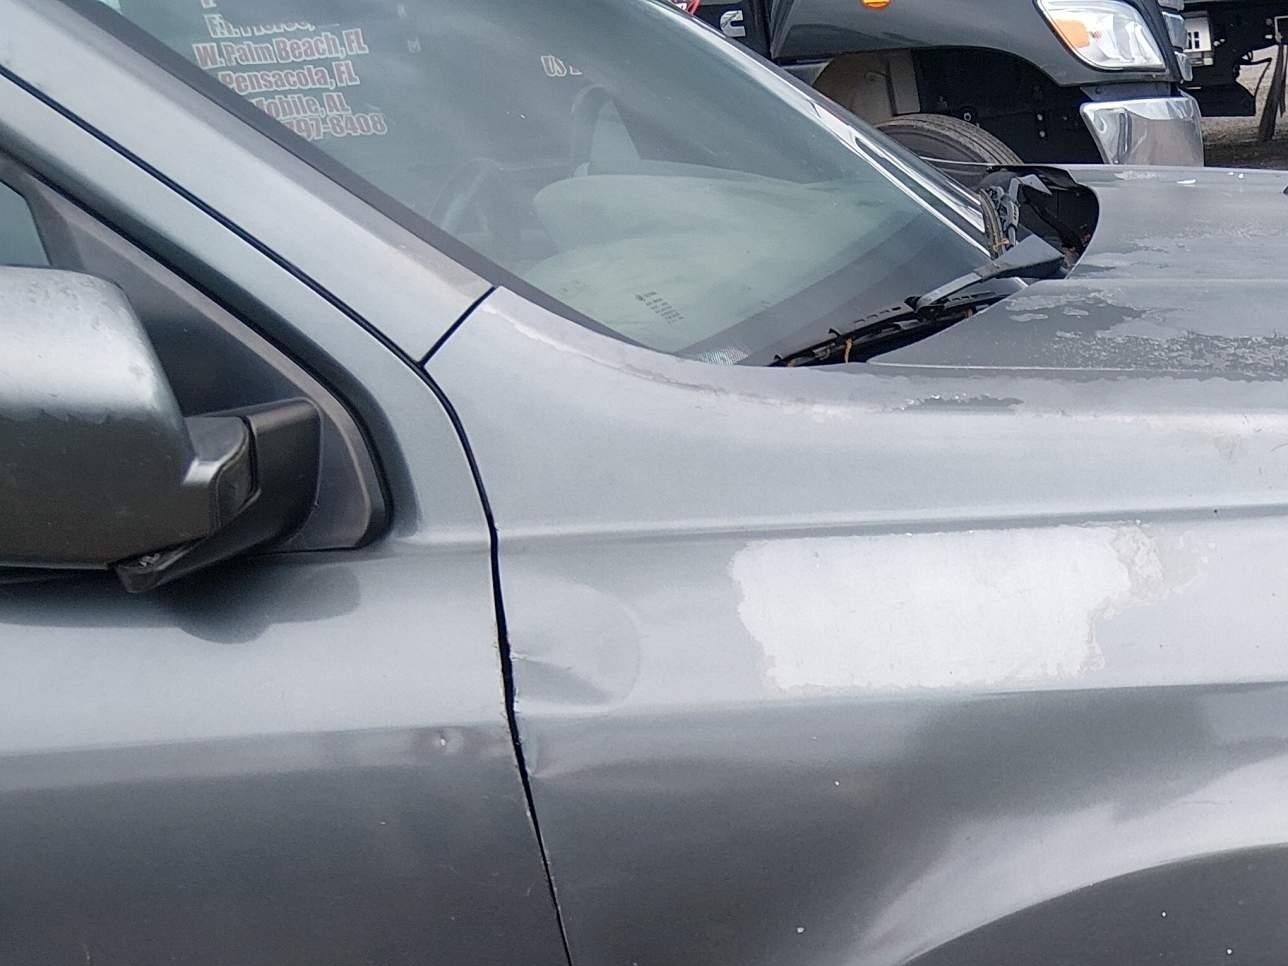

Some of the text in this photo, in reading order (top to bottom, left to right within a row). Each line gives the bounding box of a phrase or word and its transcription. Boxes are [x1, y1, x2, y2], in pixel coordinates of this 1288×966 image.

[192, 42, 225, 70] W.
[222, 41, 276, 67] Palm
[273, 32, 346, 62] Beach,
[342, 28, 369, 55] FL
[218, 60, 360, 94] Pensacola, FL
[250, 91, 352, 121] obile, AL
